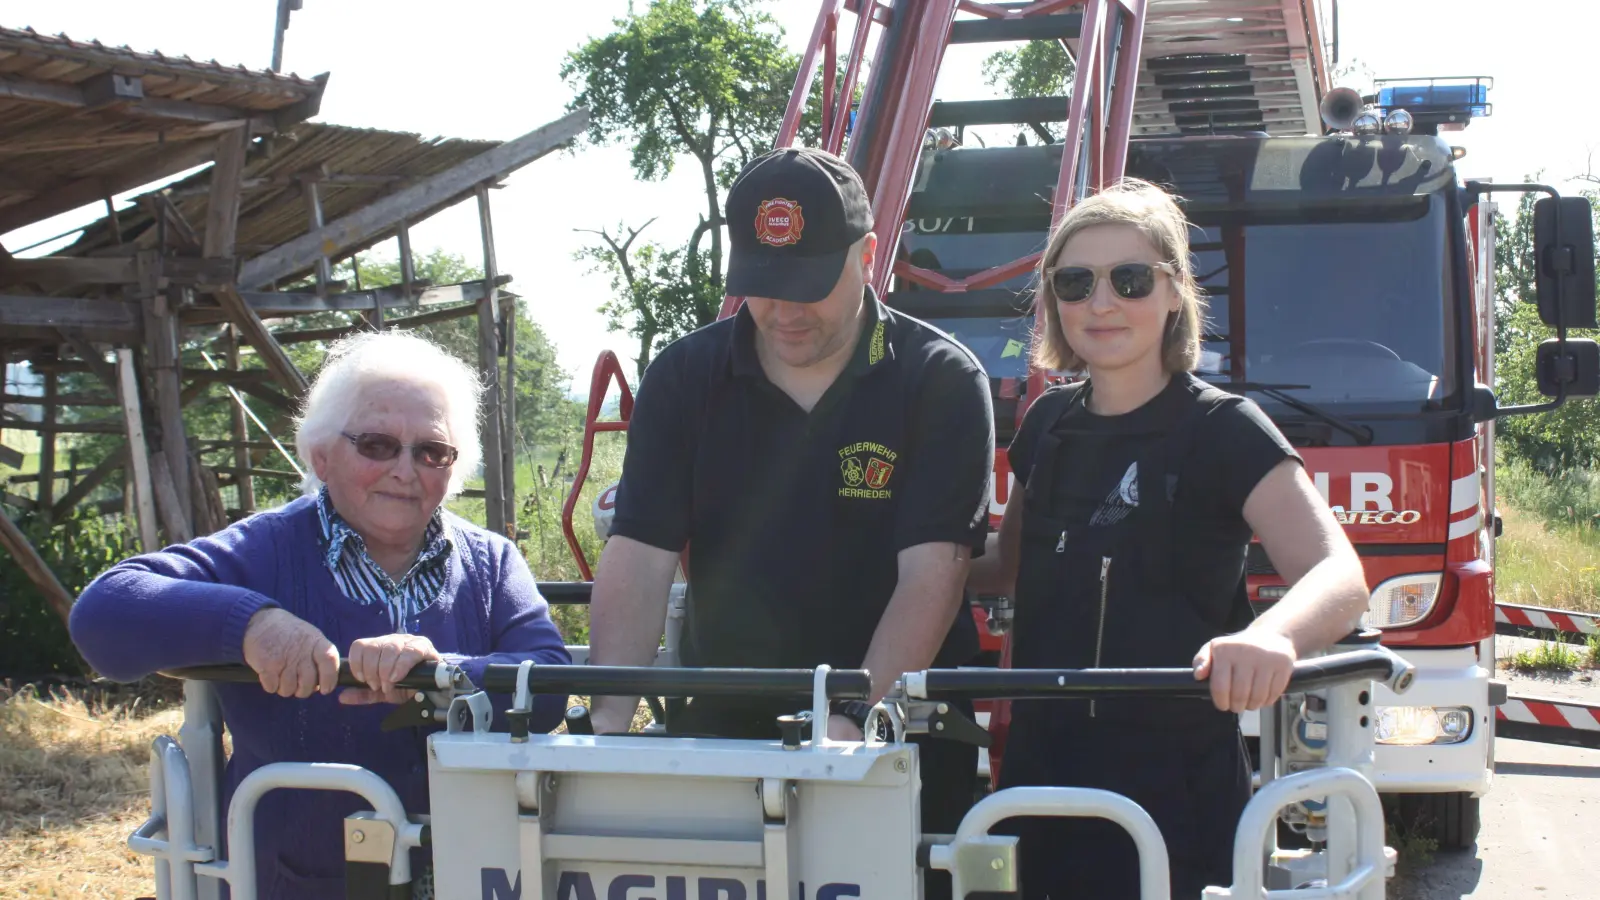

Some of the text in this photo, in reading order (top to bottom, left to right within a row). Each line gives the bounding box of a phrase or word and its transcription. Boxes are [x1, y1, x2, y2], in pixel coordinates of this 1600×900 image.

[766, 235, 791, 243] ACADEMY
[838, 441, 897, 461] FEUERWEHR
[838, 487, 892, 498] HERRIEDEN
[481, 867, 861, 900] MAGIR
